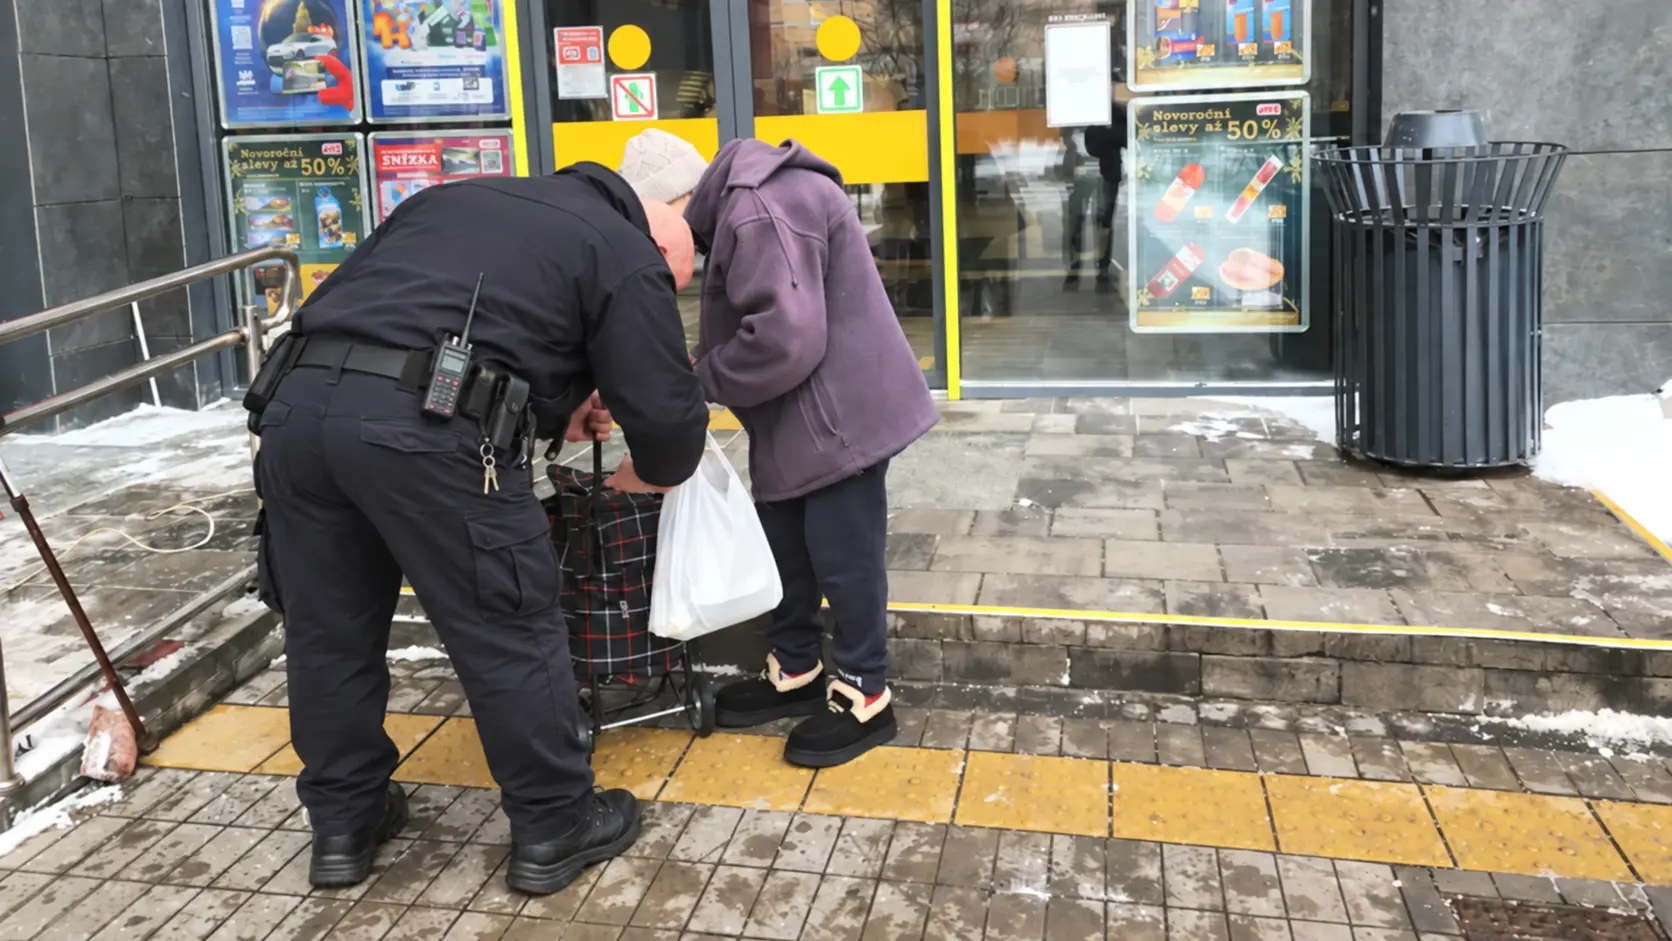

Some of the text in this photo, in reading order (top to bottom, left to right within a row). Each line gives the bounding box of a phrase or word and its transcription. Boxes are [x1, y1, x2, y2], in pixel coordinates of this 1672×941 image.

[1153, 108, 1232, 121] Novoroční
[1152, 121, 1199, 135] slevy
[1204, 120, 1223, 132] až
[240, 147, 304, 159] Novoroční
[240, 159, 278, 172] slevy
[283, 159, 298, 169] až
